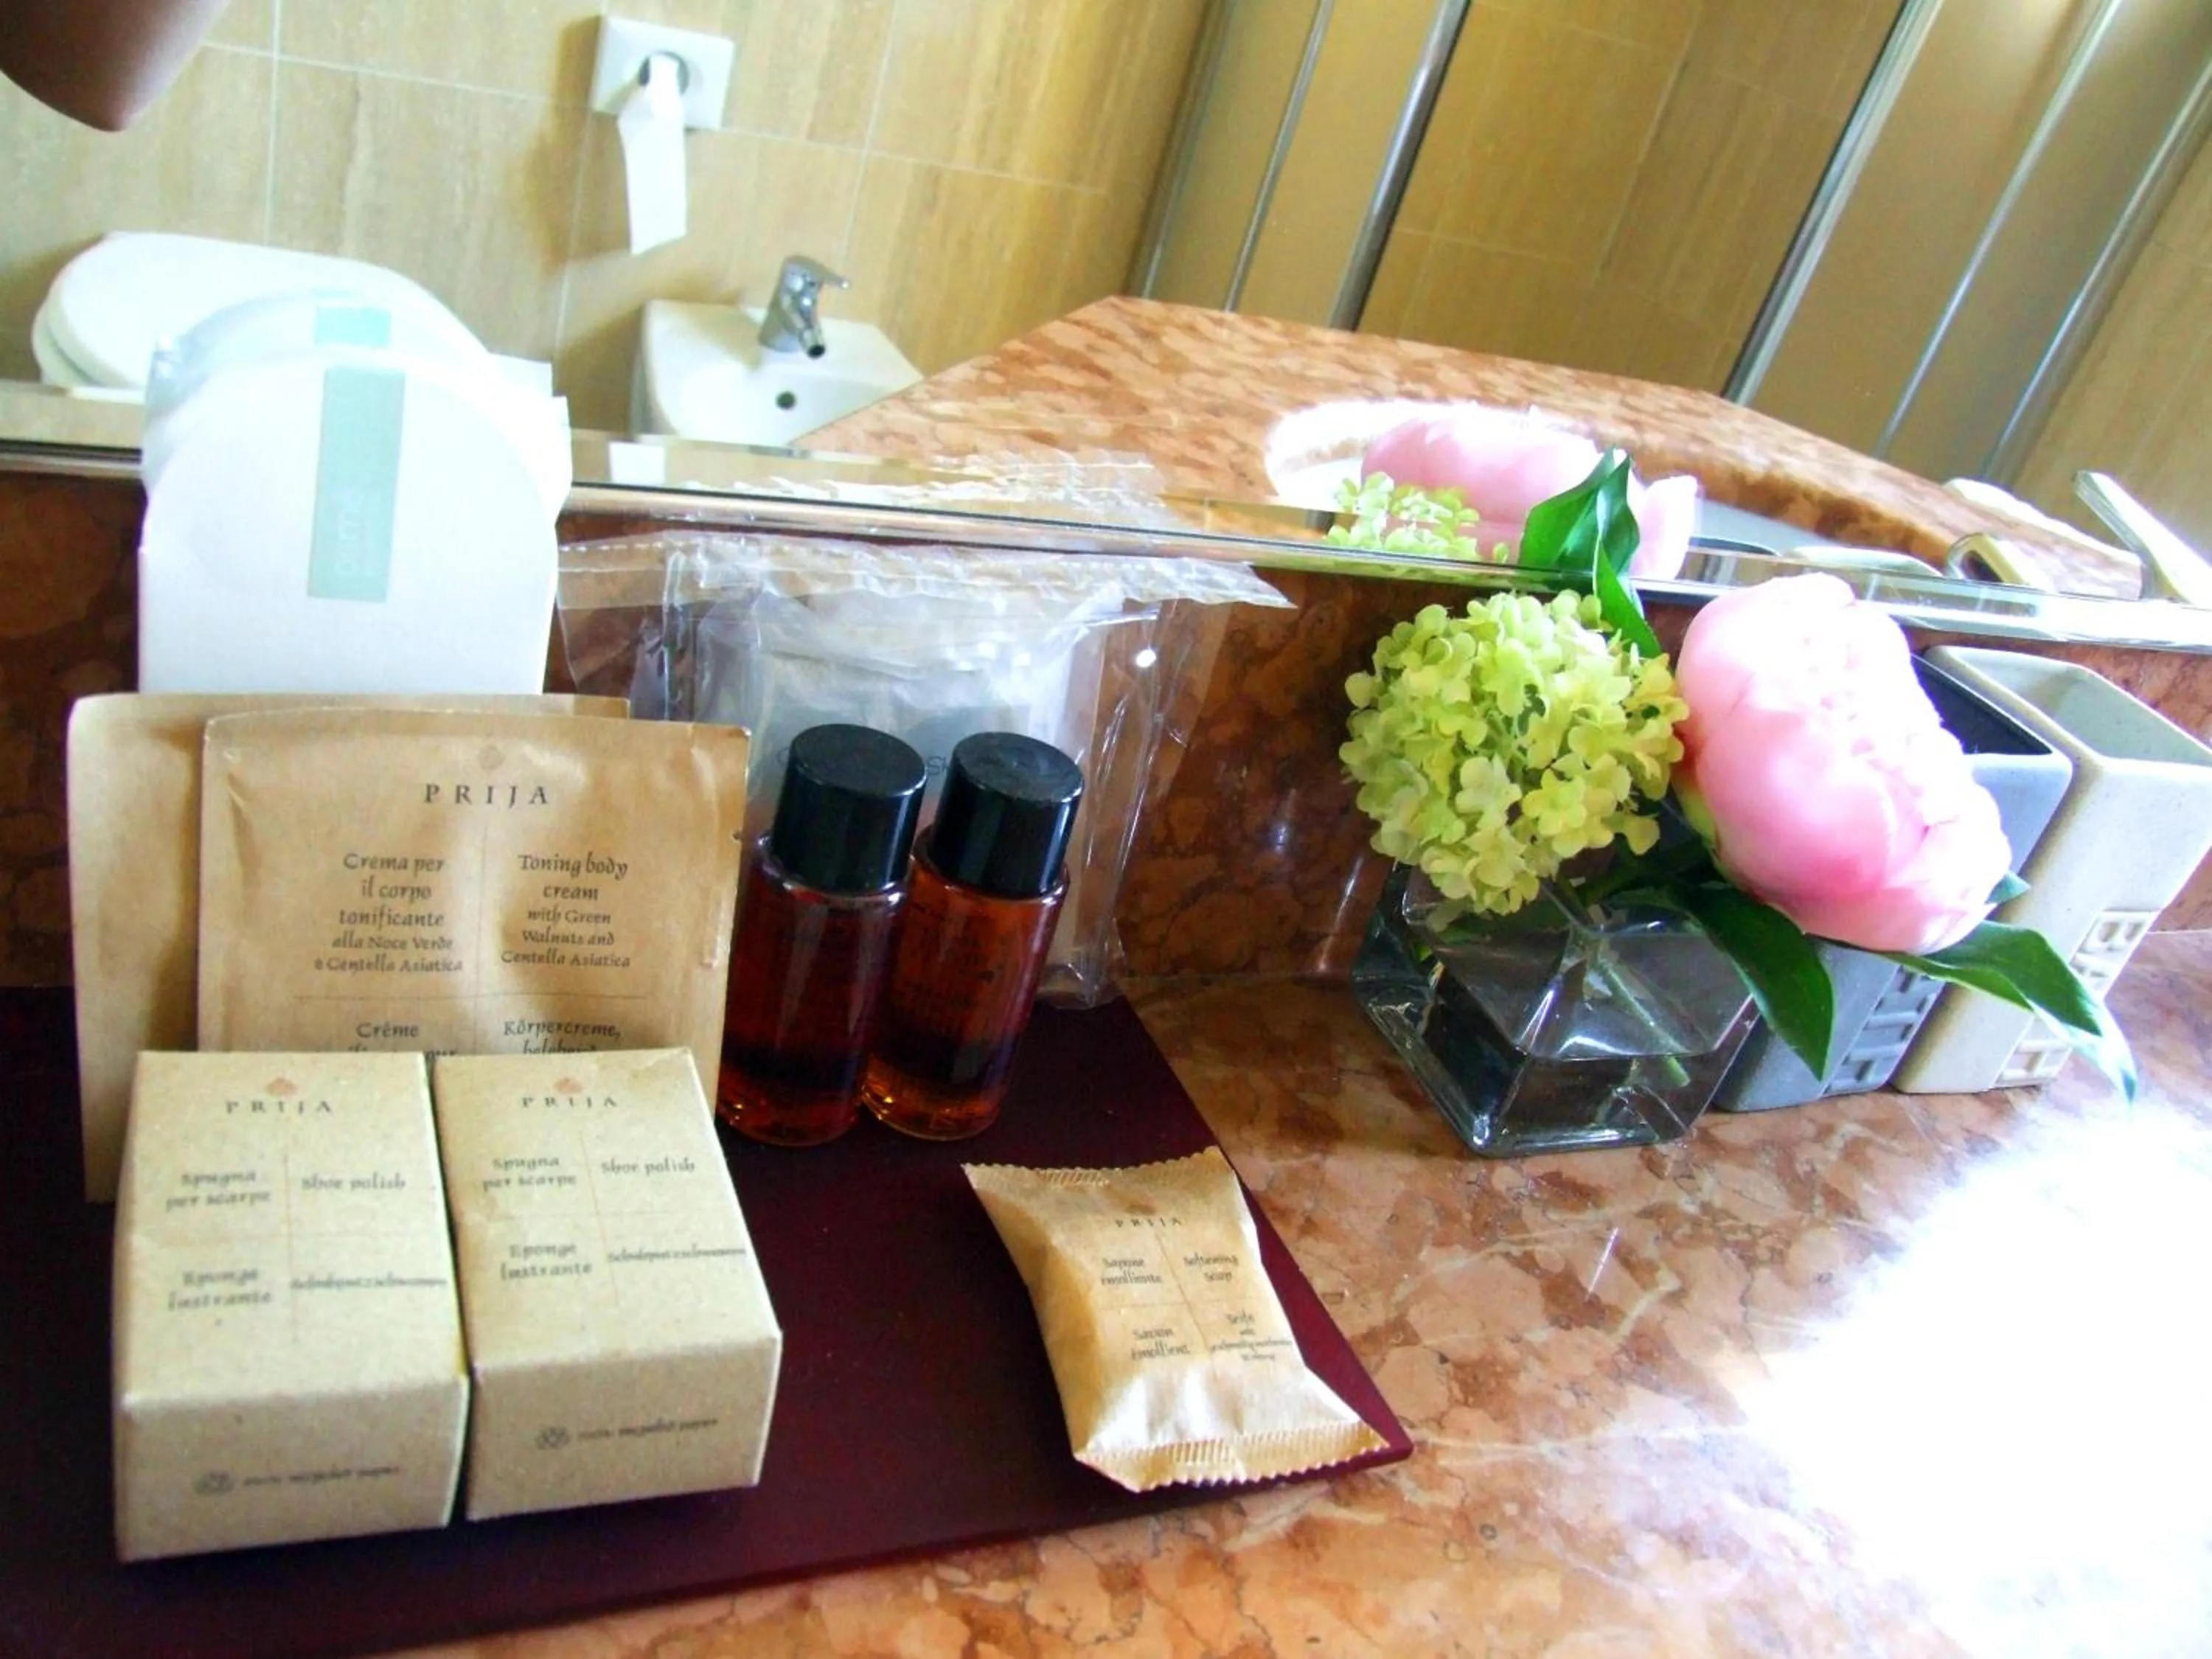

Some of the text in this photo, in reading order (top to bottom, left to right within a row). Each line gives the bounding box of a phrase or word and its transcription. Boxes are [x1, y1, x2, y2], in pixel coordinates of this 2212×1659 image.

[424, 783, 548, 809] PRIJA
[344, 853, 445, 877] Crema per
[518, 851, 628, 880] Toning body
[361, 874, 432, 904] il corpo
[543, 885, 599, 900] cream
[338, 905, 445, 931] tonificante
[528, 903, 611, 925] with Green
[332, 930, 453, 950] alla Noce Verde
[521, 925, 615, 945] Walnuts and
[327, 953, 396, 973] Centella
[400, 957, 463, 973] Asiatica
[501, 947, 631, 968] Centella Asiatica
[226, 1100, 333, 1114] PRIJA
[521, 1096, 618, 1108] PRIJA
